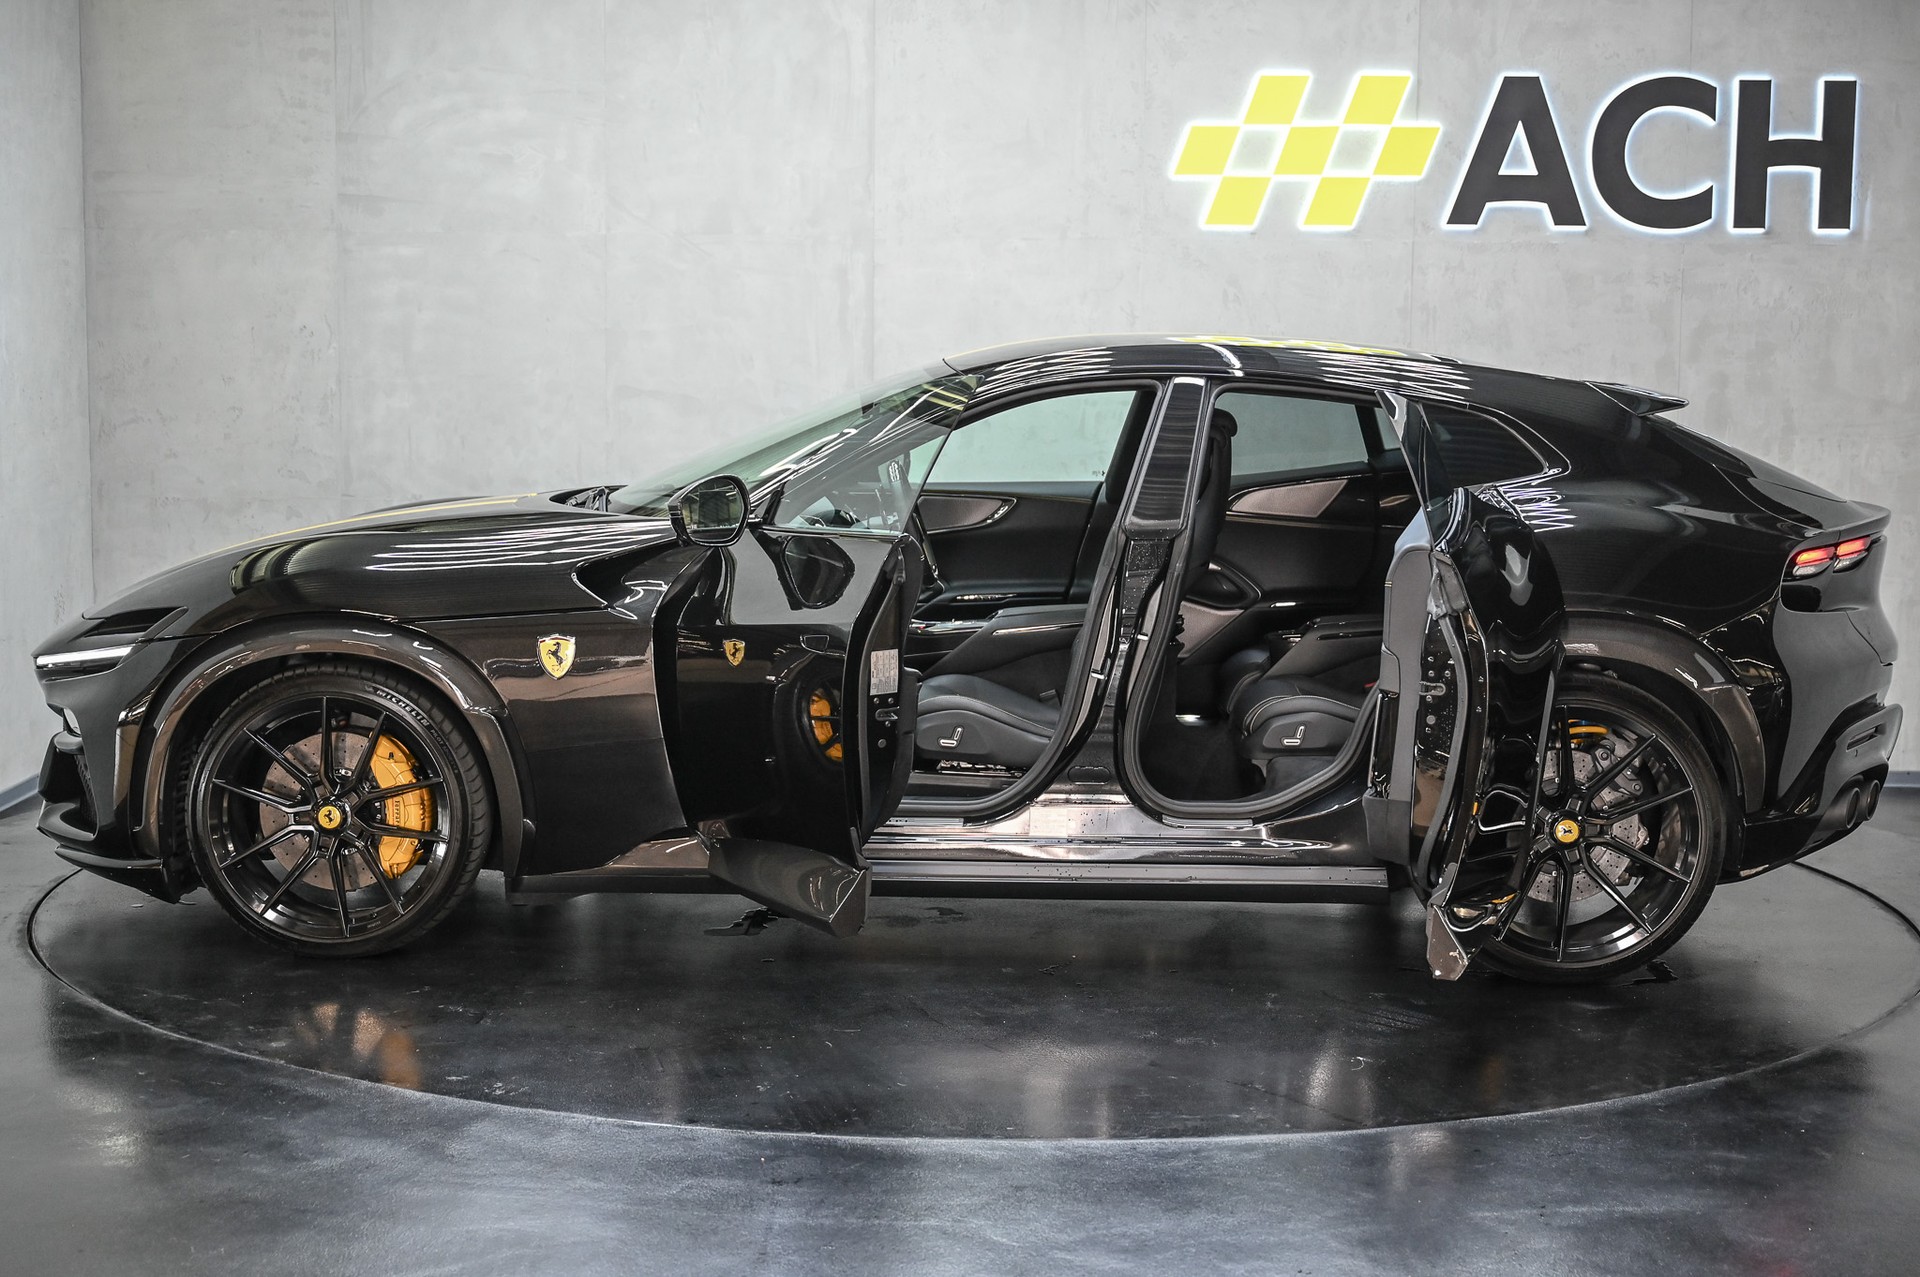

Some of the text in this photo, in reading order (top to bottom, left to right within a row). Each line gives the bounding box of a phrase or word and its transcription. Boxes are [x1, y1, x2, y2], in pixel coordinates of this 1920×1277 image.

[1444, 74, 1858, 231] ACH
[376, 689, 444, 745] MICHELIN PILOT
